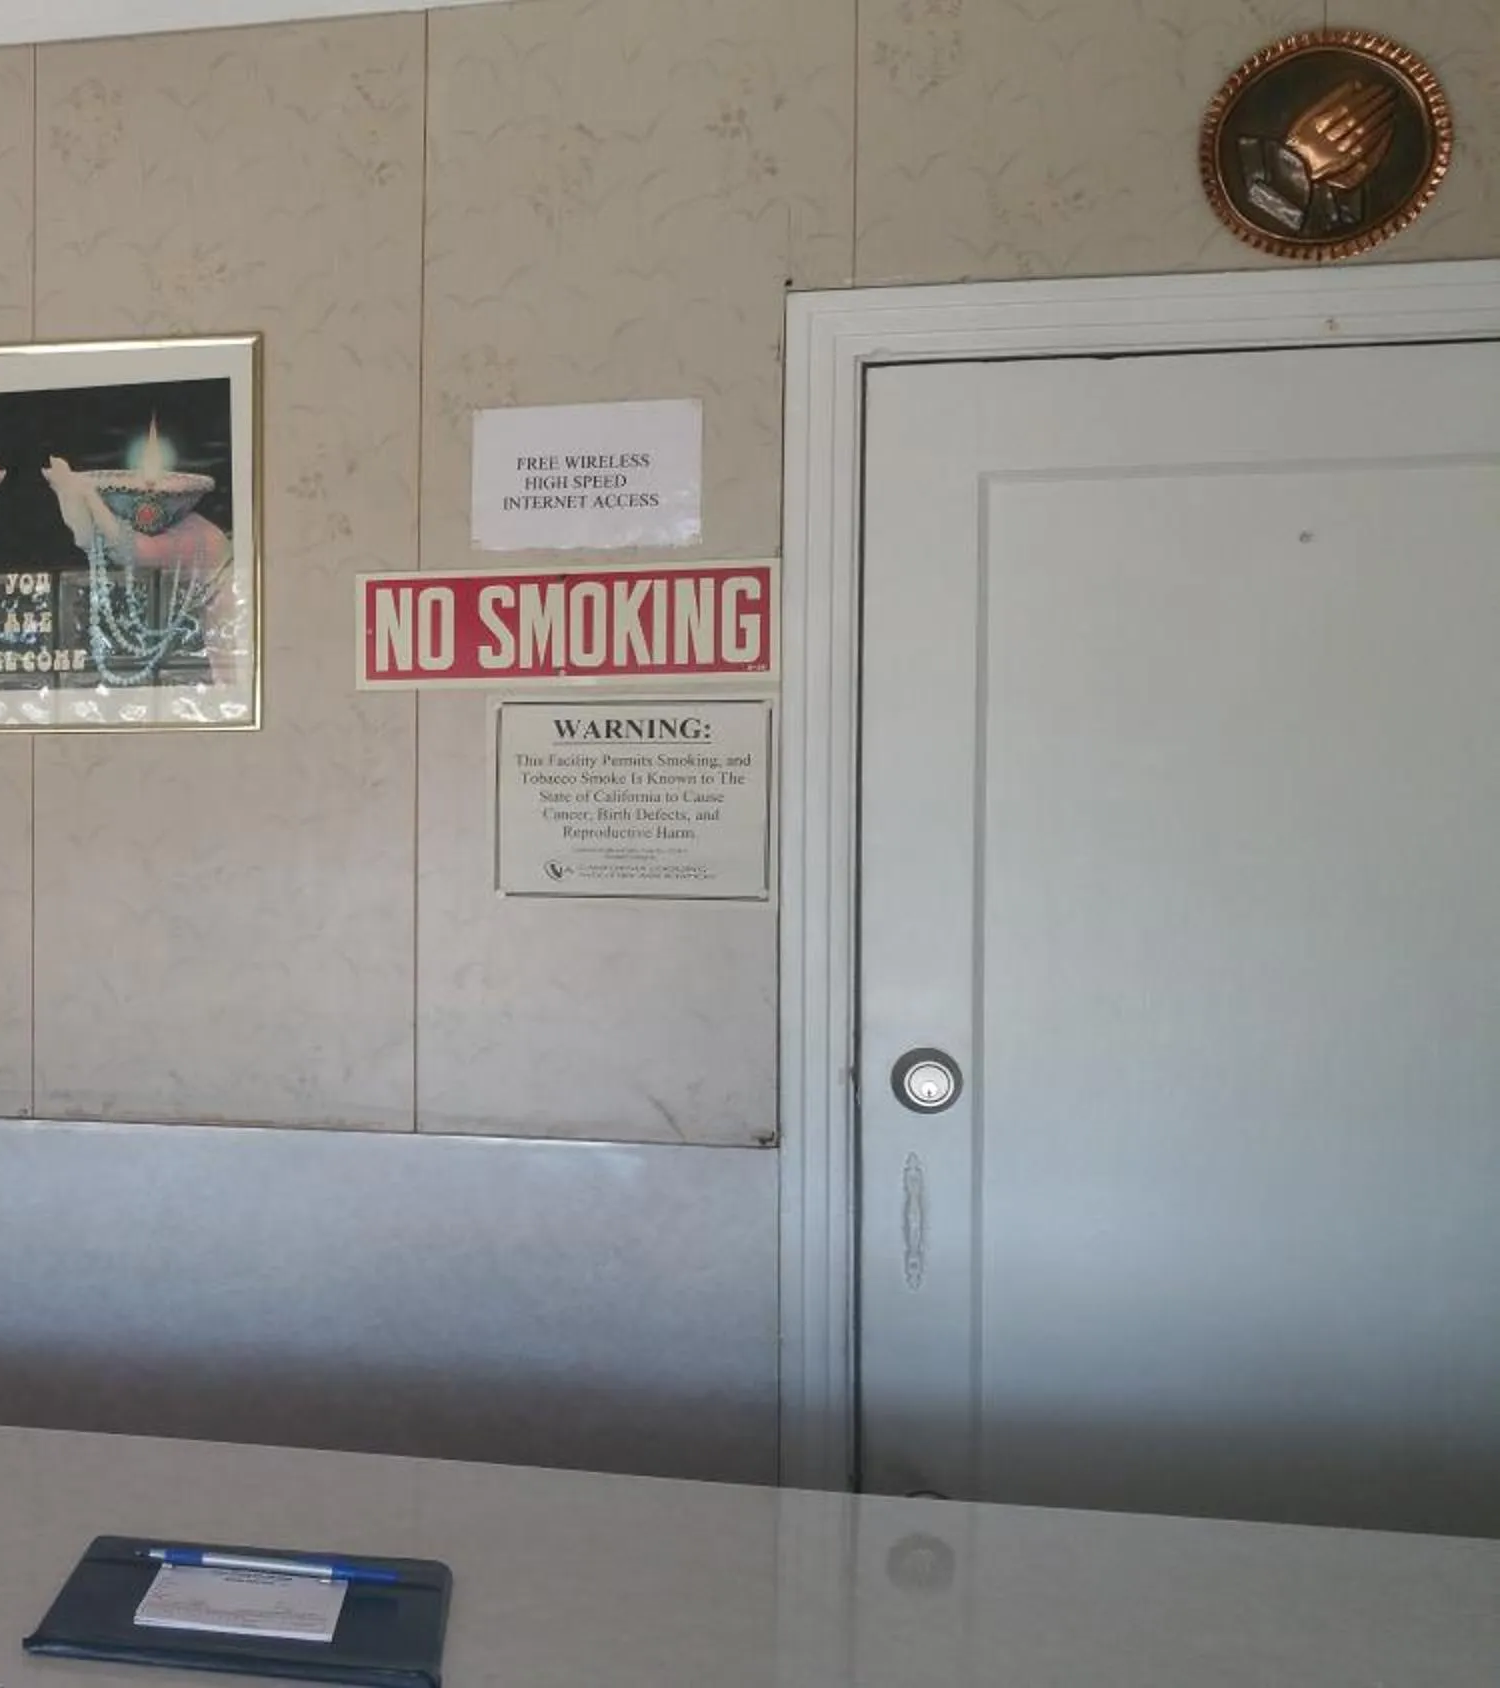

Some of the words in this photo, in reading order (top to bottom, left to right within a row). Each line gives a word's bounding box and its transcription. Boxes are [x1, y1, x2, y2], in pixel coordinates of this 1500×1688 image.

[516, 455, 560, 471] FREE
[565, 453, 651, 469] WIRELESS
[524, 475, 568, 490] HIGH
[572, 473, 627, 489] SPEED
[503, 494, 588, 510] INTERNET
[593, 492, 660, 508] ACCESS
[376, 587, 455, 672] NO
[477, 576, 762, 671] SMOKING
[553, 718, 712, 740] WARNING:
[516, 754, 544, 767] This
[549, 754, 596, 770] Facility
[602, 754, 653, 768] Permits
[727, 754, 752, 767] and
[522, 772, 577, 785] Tobacco
[580, 772, 627, 785] Smoke
[631, 772, 643, 785] Is
[647, 772, 698, 785] Known
[701, 773, 716, 785] to
[719, 771, 746, 785] The
[539, 791, 572, 803] State
[576, 790, 590, 803] of
[593, 790, 662, 803] California
[665, 792, 680, 803] to
[597, 808, 632, 821] Birth
[695, 808, 721, 821] and
[562, 827, 653, 842] Reproductive
